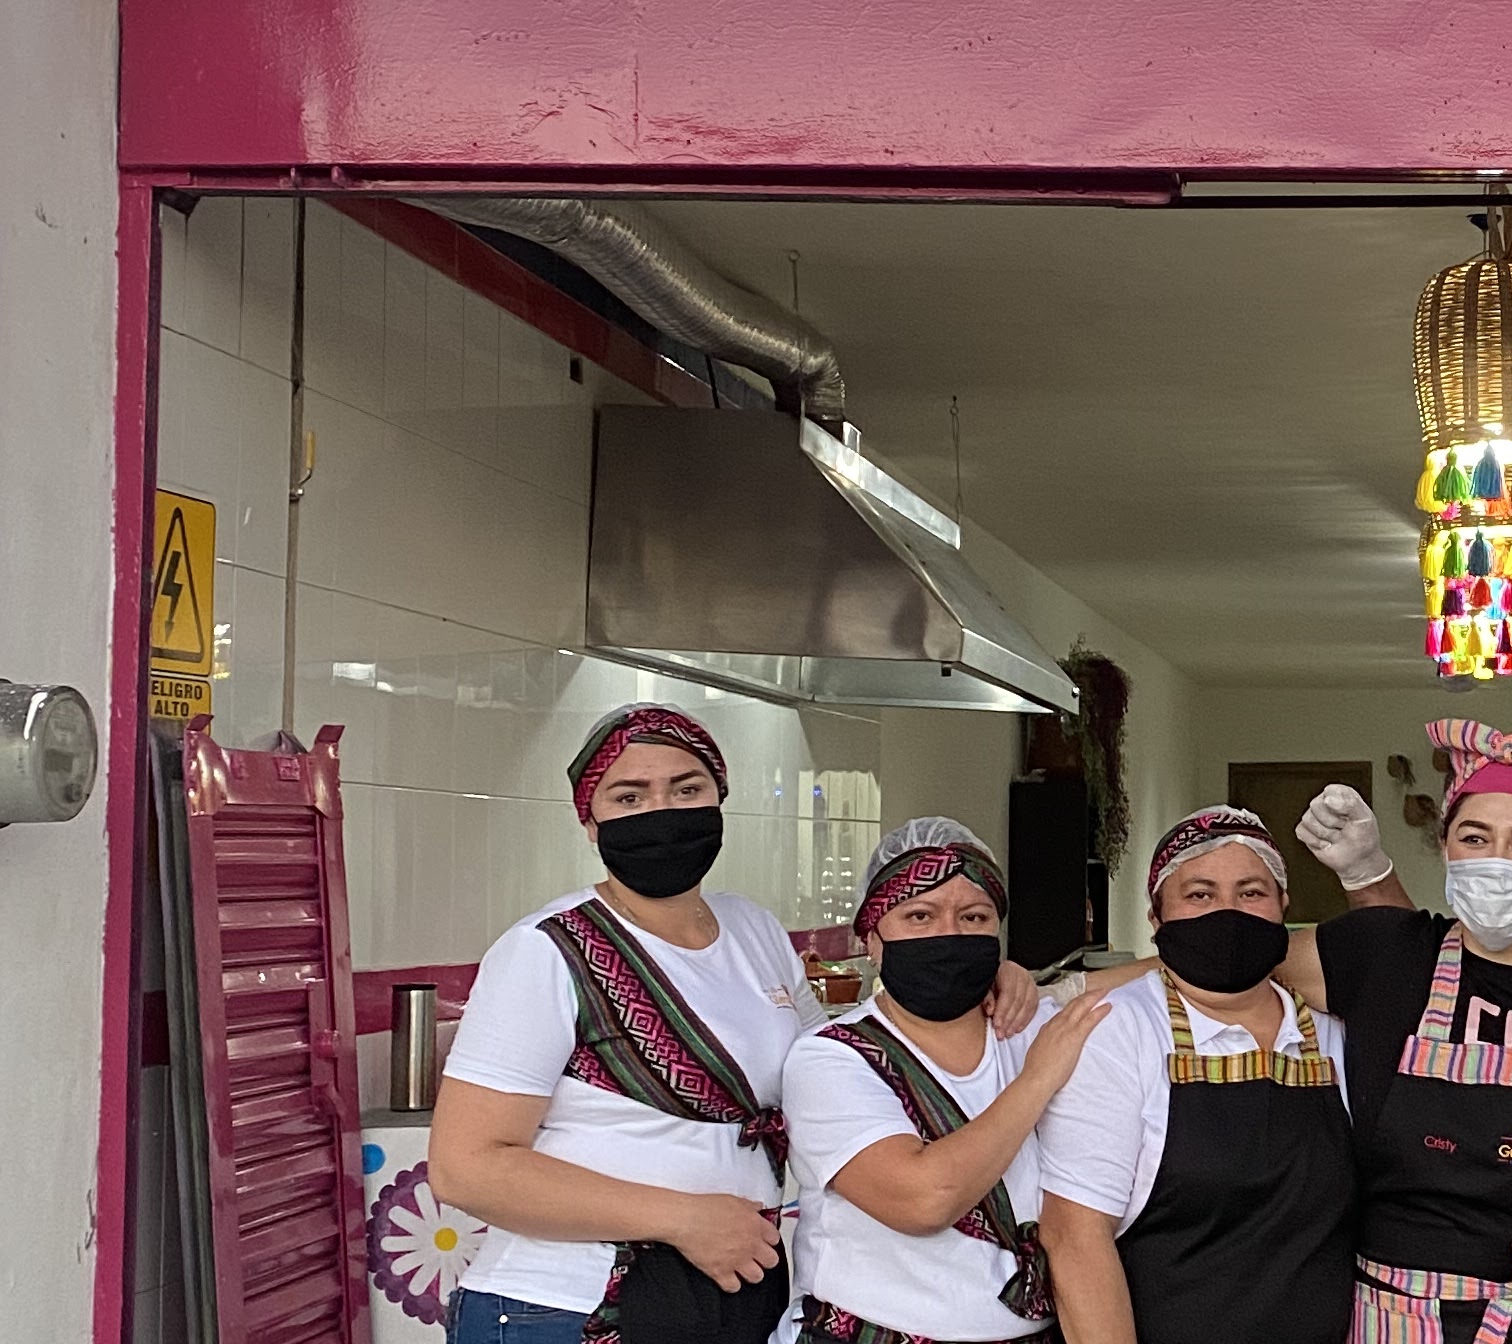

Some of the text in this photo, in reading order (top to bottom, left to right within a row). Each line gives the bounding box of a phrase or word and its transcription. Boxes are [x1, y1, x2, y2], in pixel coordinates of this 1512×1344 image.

[151, 680, 203, 701] ELIGRO
[154, 700, 190, 717] ALTO
[1423, 1135, 1458, 1153] Cristy
